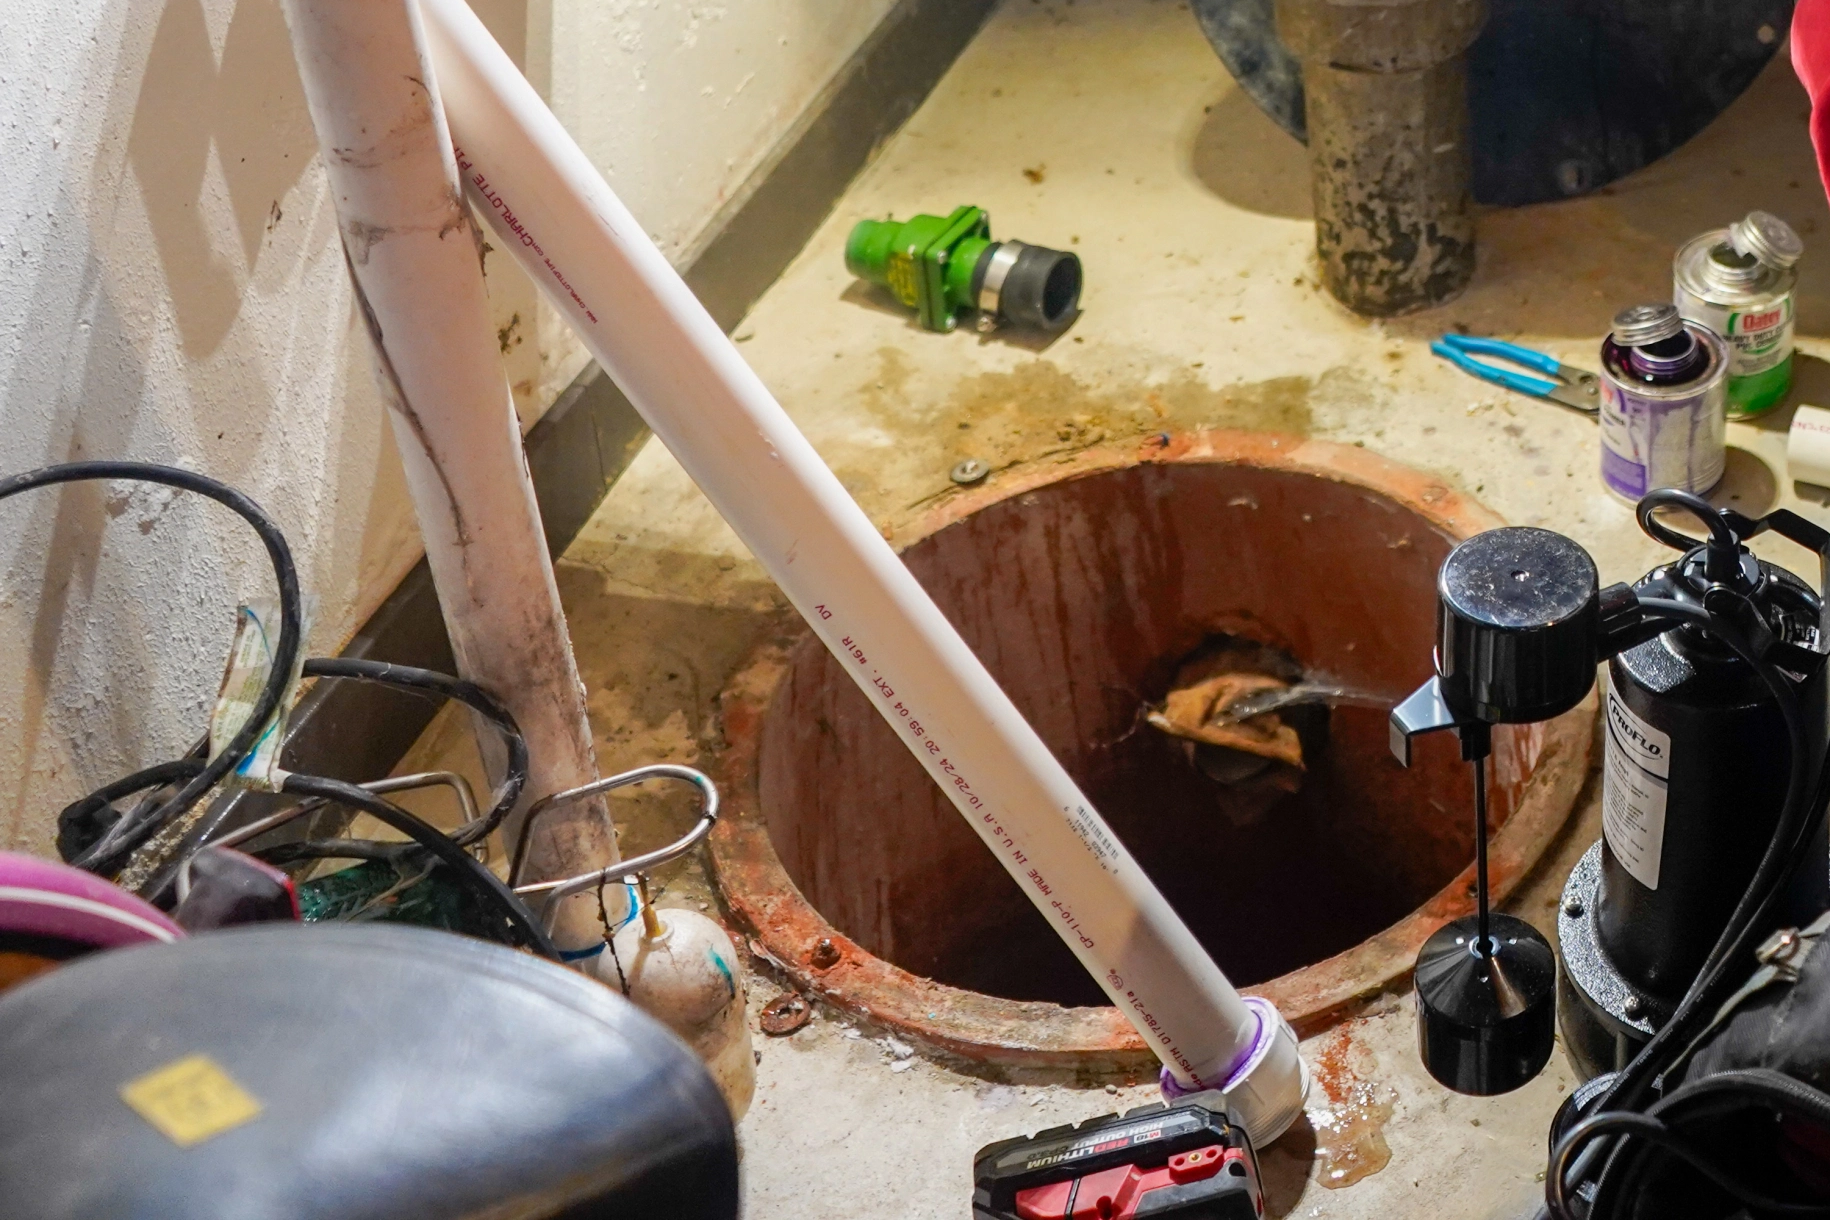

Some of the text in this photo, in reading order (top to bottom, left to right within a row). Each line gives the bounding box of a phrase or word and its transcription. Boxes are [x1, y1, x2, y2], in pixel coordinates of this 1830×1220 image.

[469, 172, 536, 248] CHARLOTTE
[839, 633, 869, 667] #61R
[891, 698, 941, 758] 20:59:04
[1612, 703, 1662, 756] PROFLO
[937, 755, 984, 812] 10/28/24
[1011, 848, 1029, 866] IN
[1026, 866, 1053, 898] MADE
[1050, 896, 1095, 951] CP-110-P
[1124, 988, 1172, 1047] D1785-21a
[1169, 1045, 1194, 1074] ASTM
[1069, 1129, 1127, 1152] OUTPUT
[1127, 1120, 1164, 1136] HIGH
[1025, 1135, 1130, 1171] REDLITHIUM
